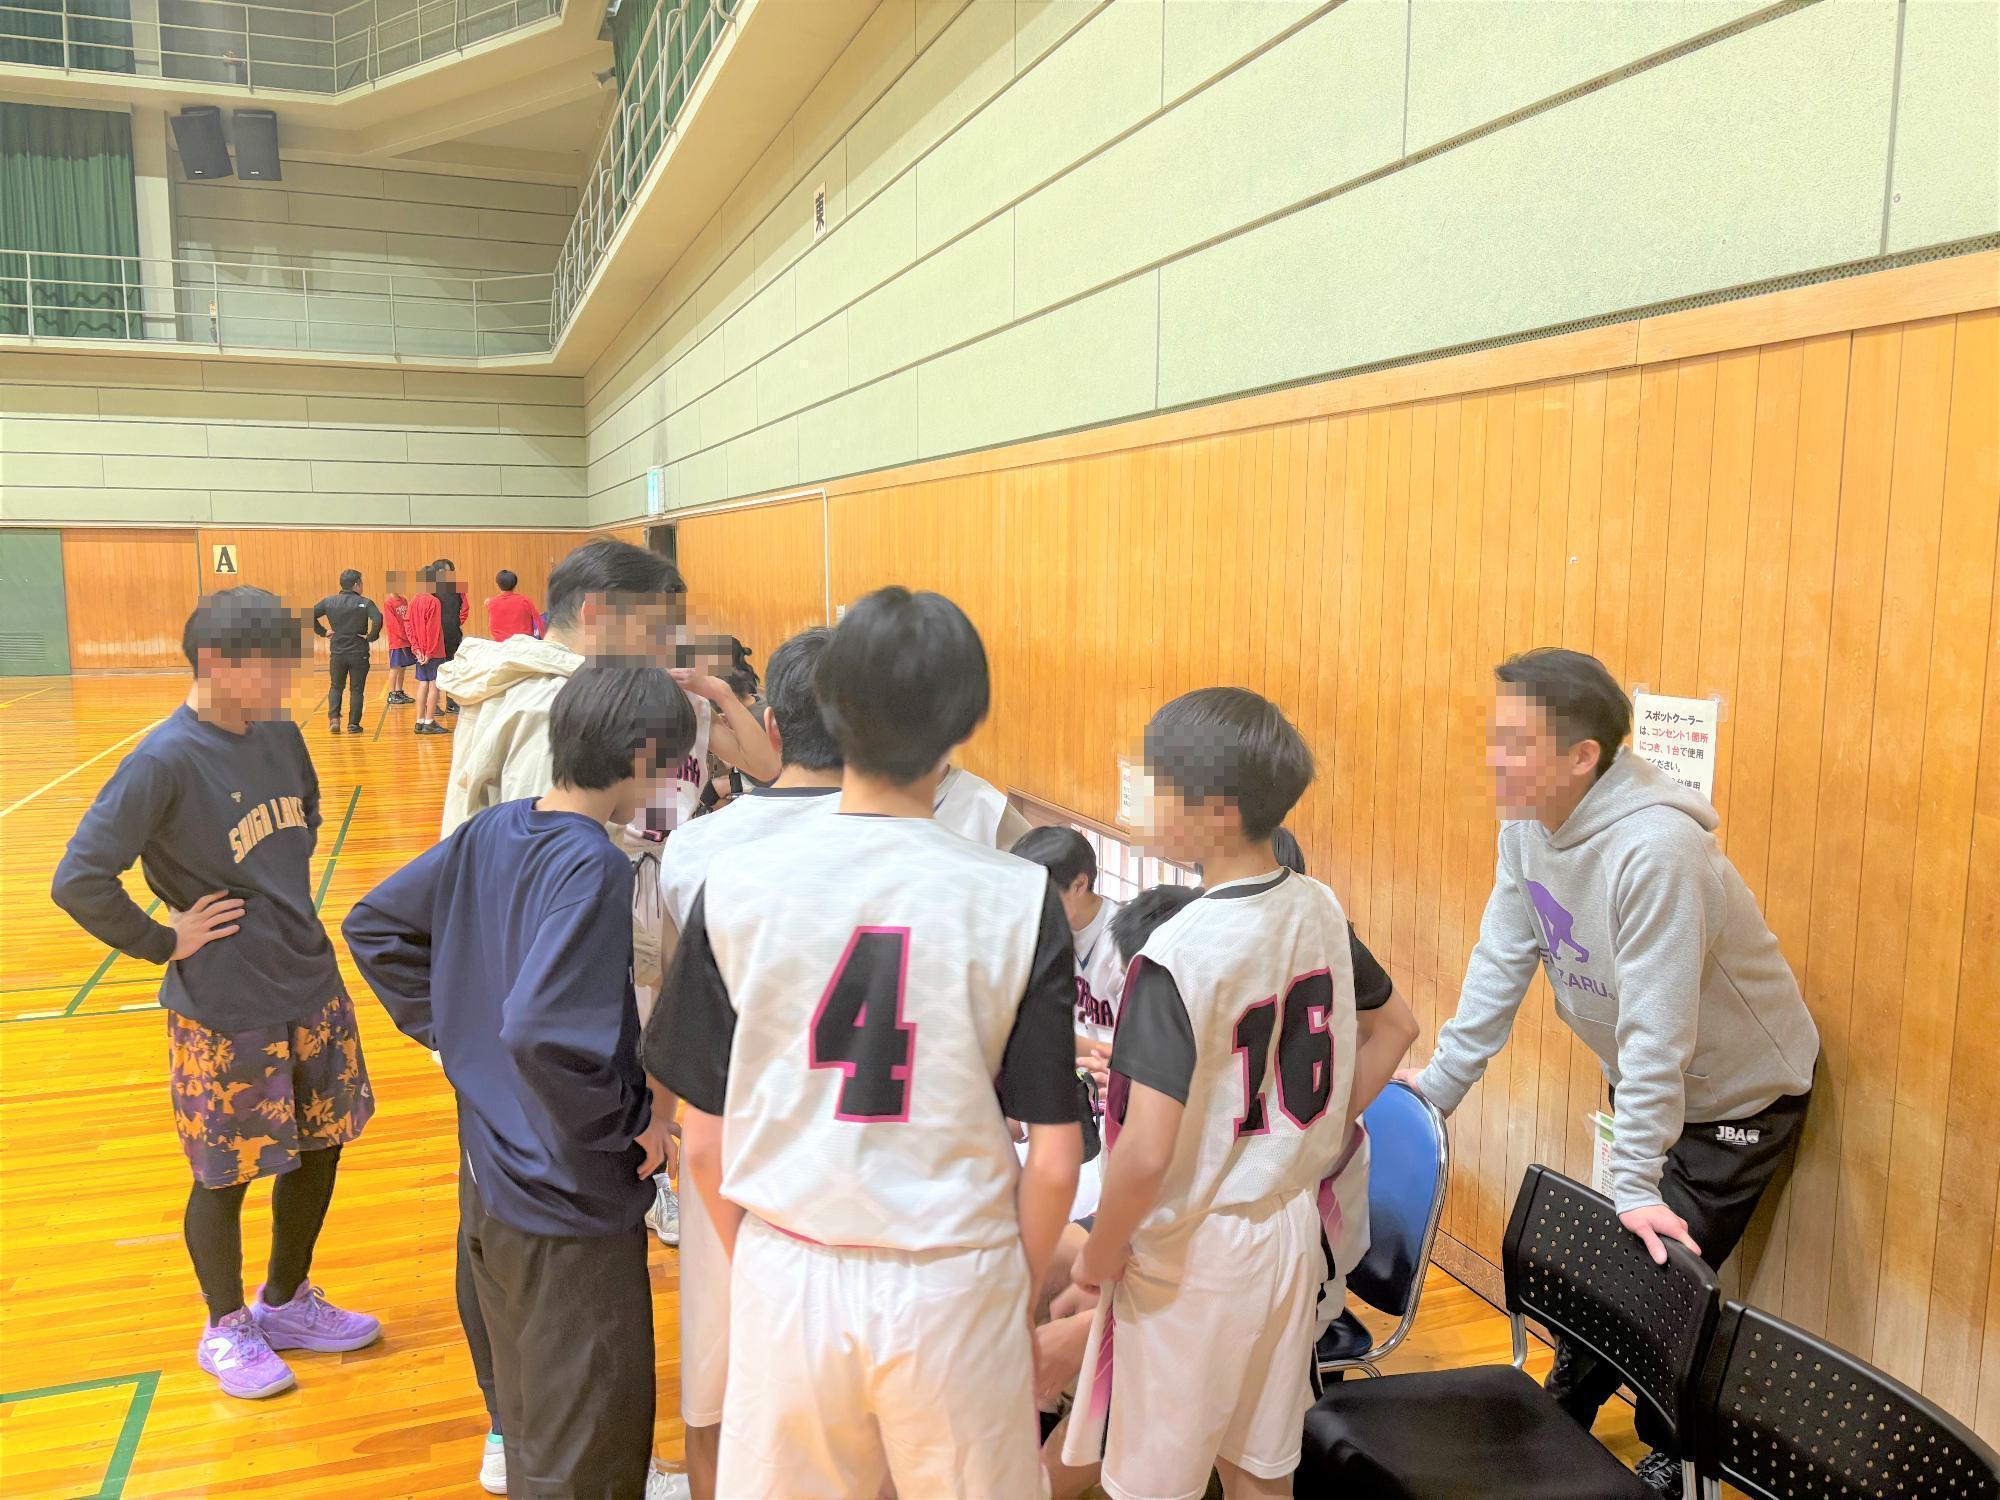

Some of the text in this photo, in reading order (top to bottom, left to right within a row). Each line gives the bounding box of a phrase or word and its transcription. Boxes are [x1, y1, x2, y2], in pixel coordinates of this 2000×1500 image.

[216, 546, 236, 572] A
[1645, 710, 1704, 725] スポットクーラー
[808, 924, 917, 1124] 4
[1232, 966, 1335, 1142] 16
[1716, 1125, 1747, 1142] JBA
